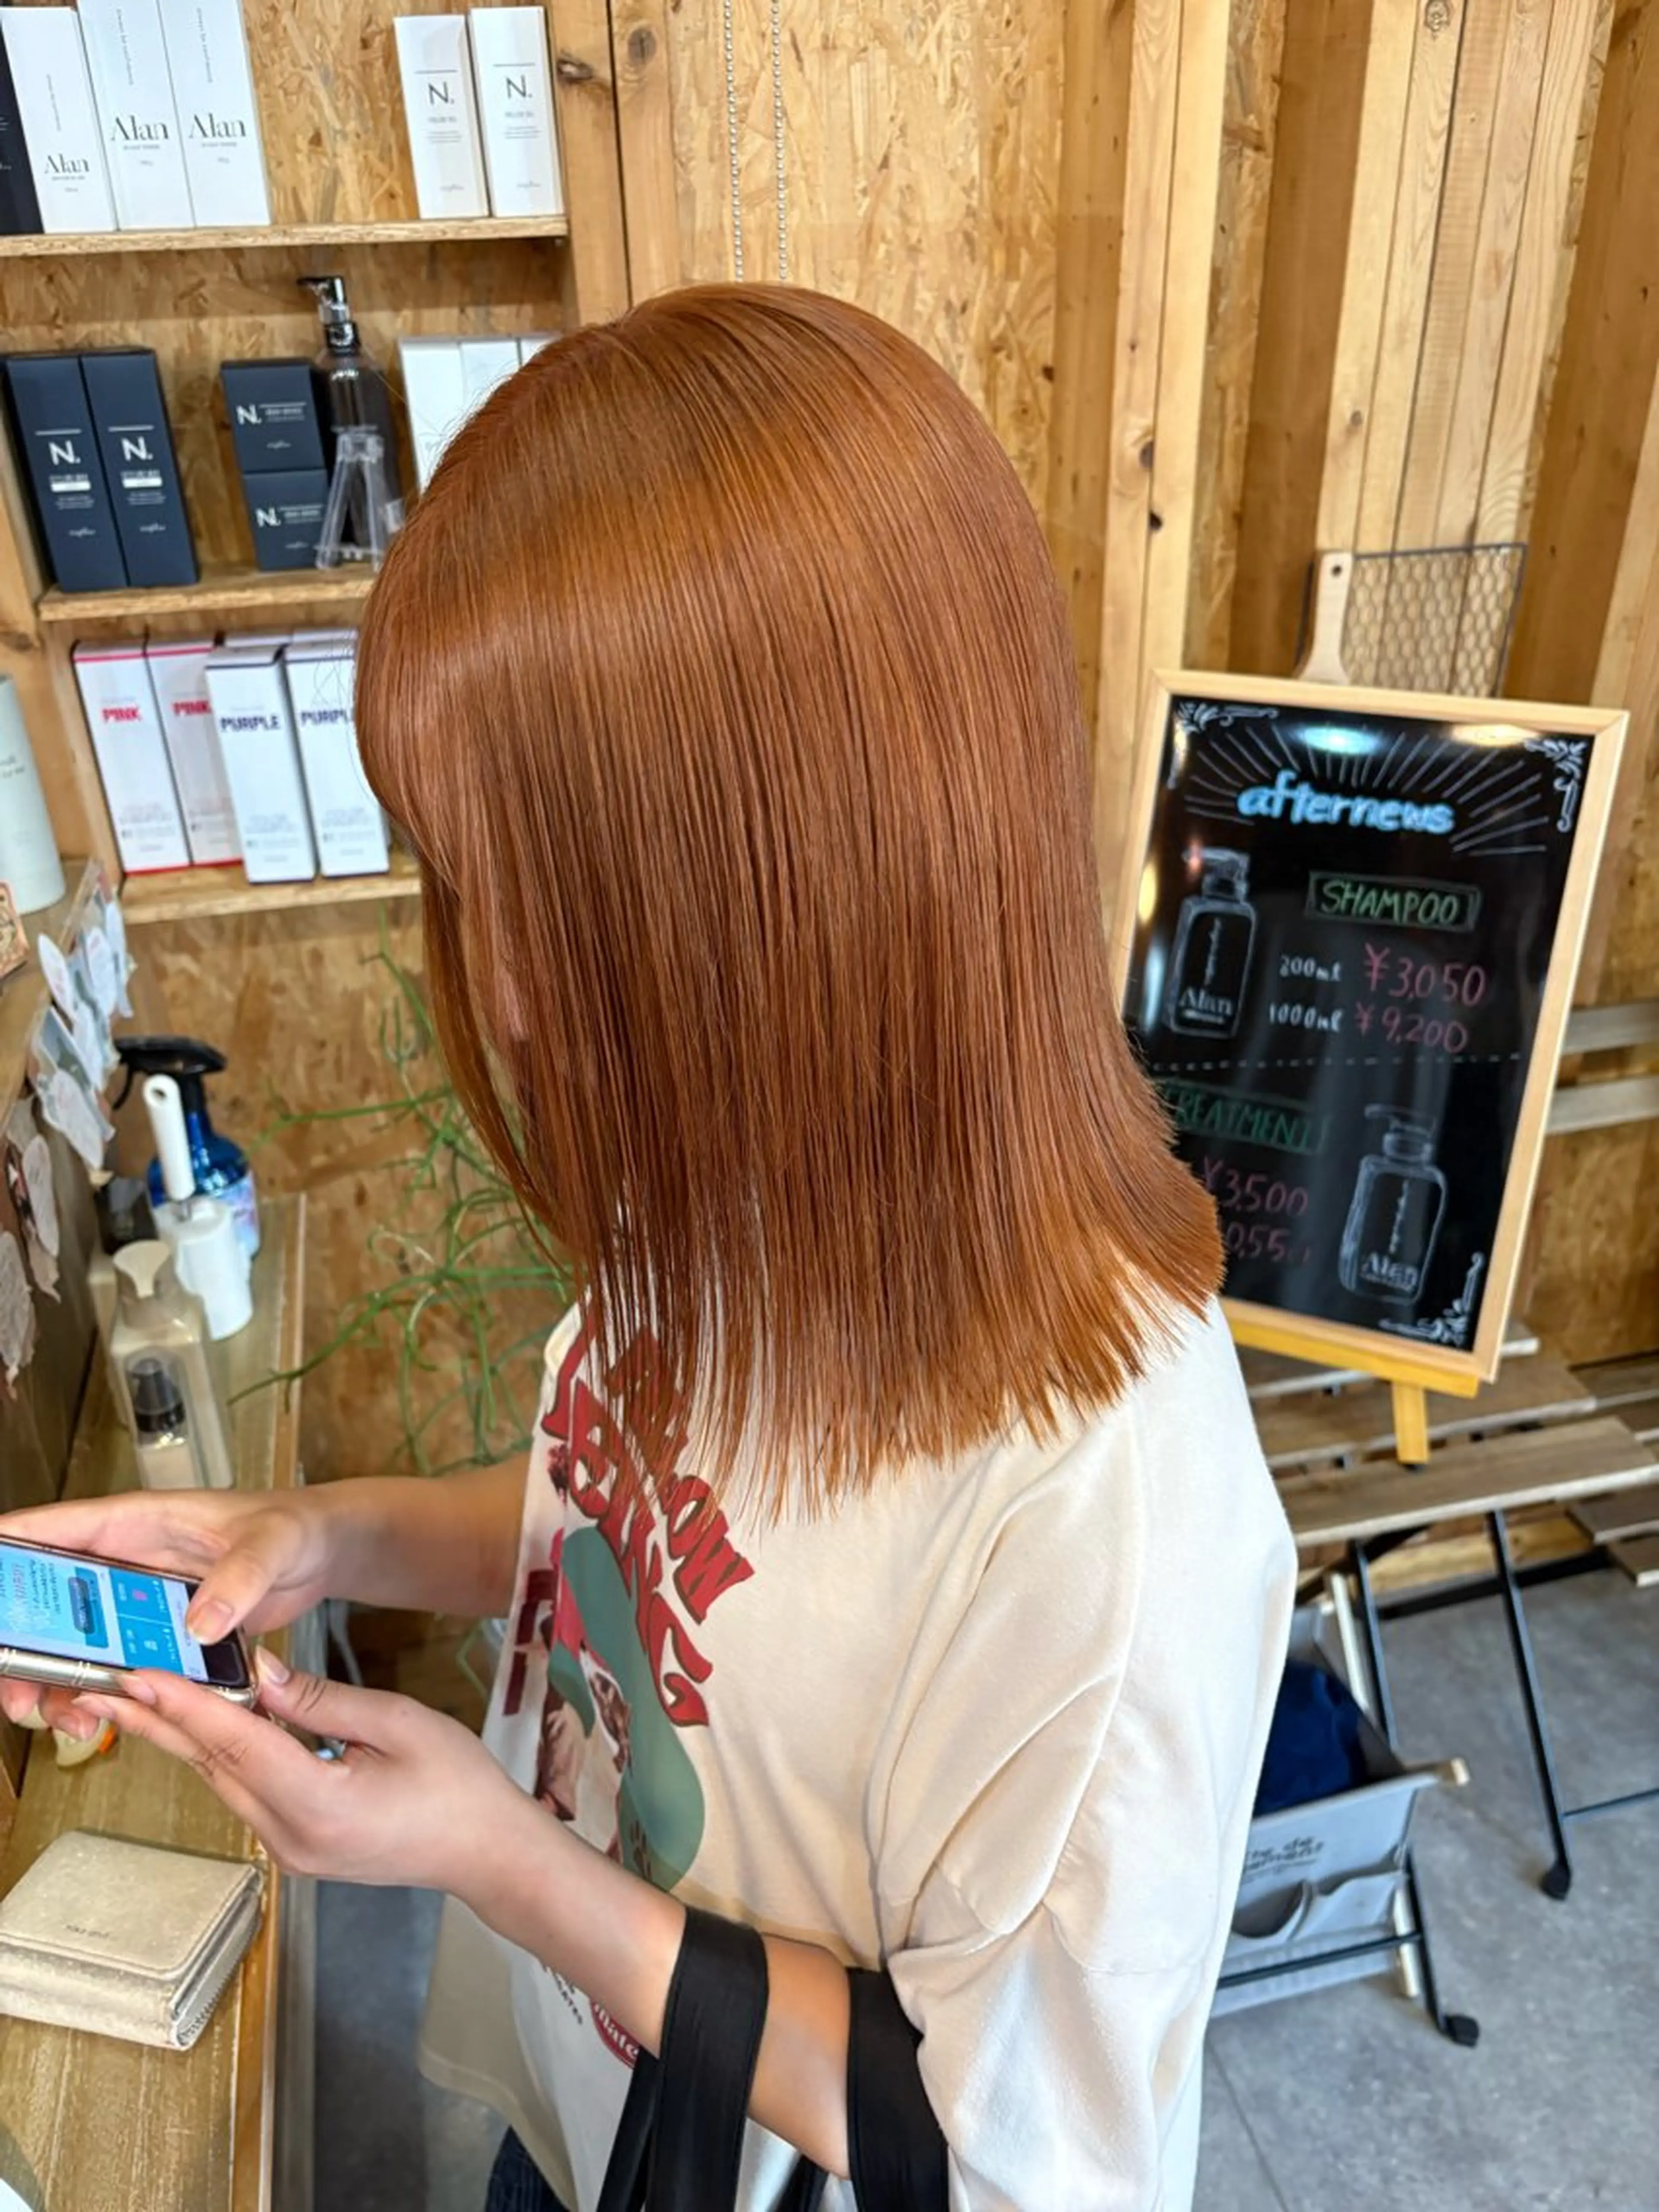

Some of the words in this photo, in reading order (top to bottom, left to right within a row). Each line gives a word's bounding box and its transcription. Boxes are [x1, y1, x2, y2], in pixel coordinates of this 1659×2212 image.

[111, 114, 169, 141] Alan
[188, 112, 246, 139] Alan
[44, 153, 90, 174] Alan
[101, 707, 143, 725] PINK
[172, 700, 211, 717] PINK
[220, 715, 281, 732] PURPLE
[1236, 769, 1455, 834] afternews
[1320, 879, 1460, 925] SHAMPOO
